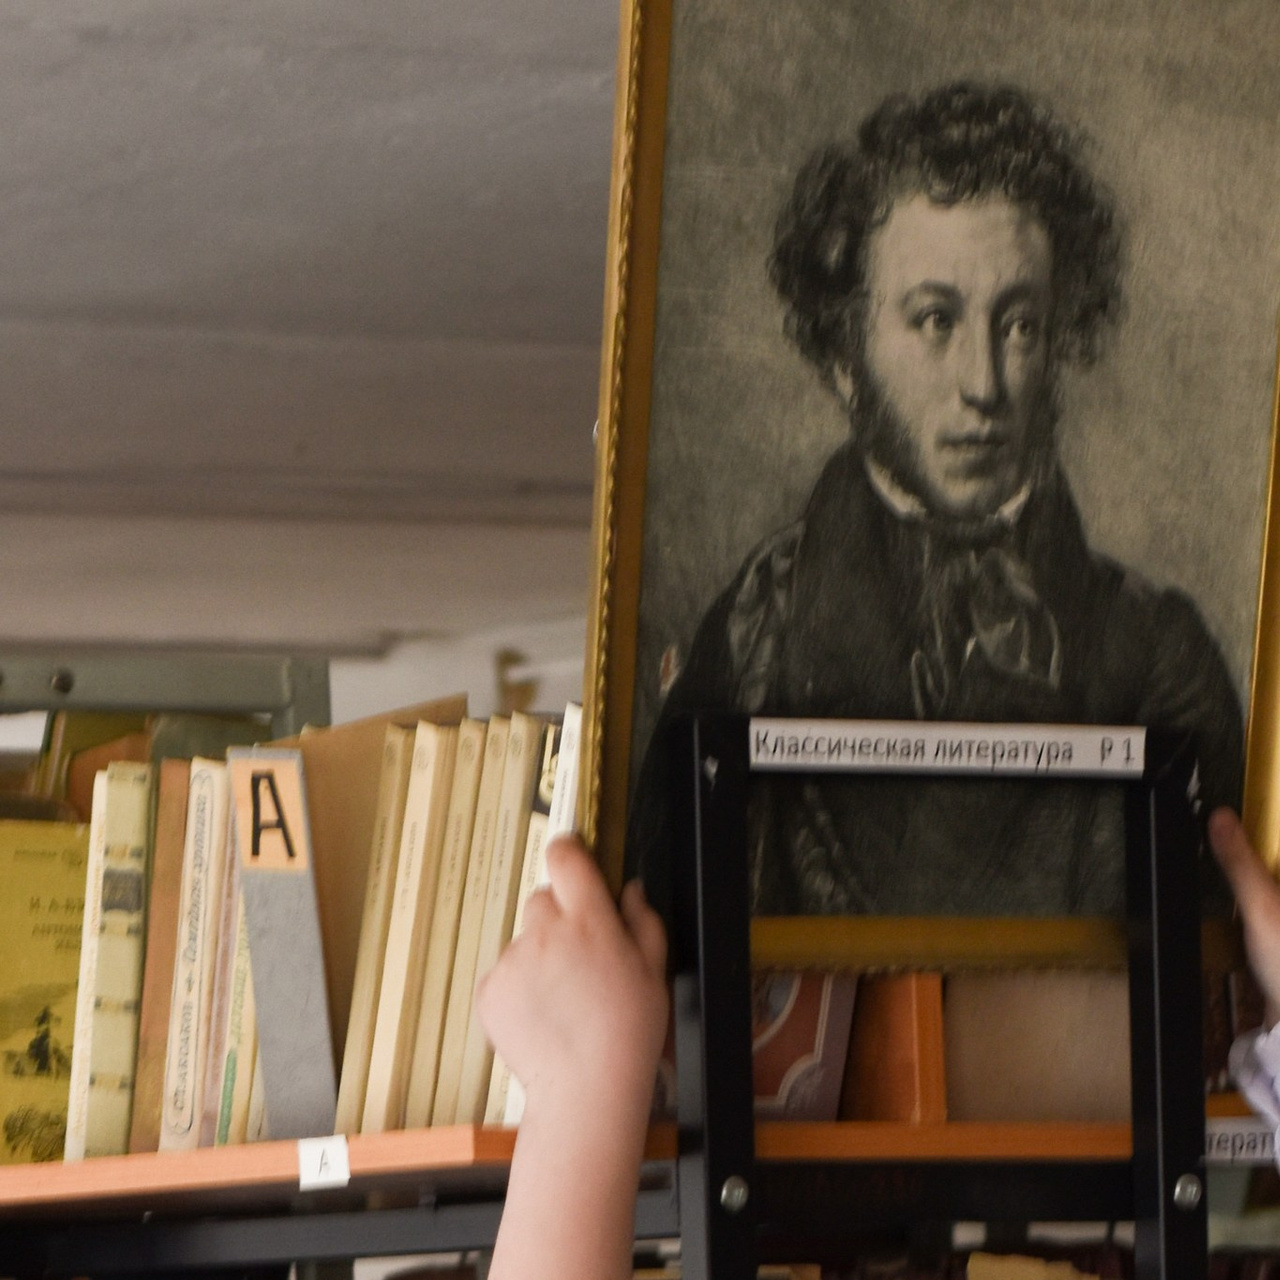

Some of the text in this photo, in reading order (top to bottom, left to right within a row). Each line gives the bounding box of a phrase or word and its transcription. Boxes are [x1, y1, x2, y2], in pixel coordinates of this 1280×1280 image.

[754, 729, 926, 761] Классическая
[933, 738, 1074, 774] литература
[1122, 736, 1136, 764] 1
[250, 769, 296, 858] А
